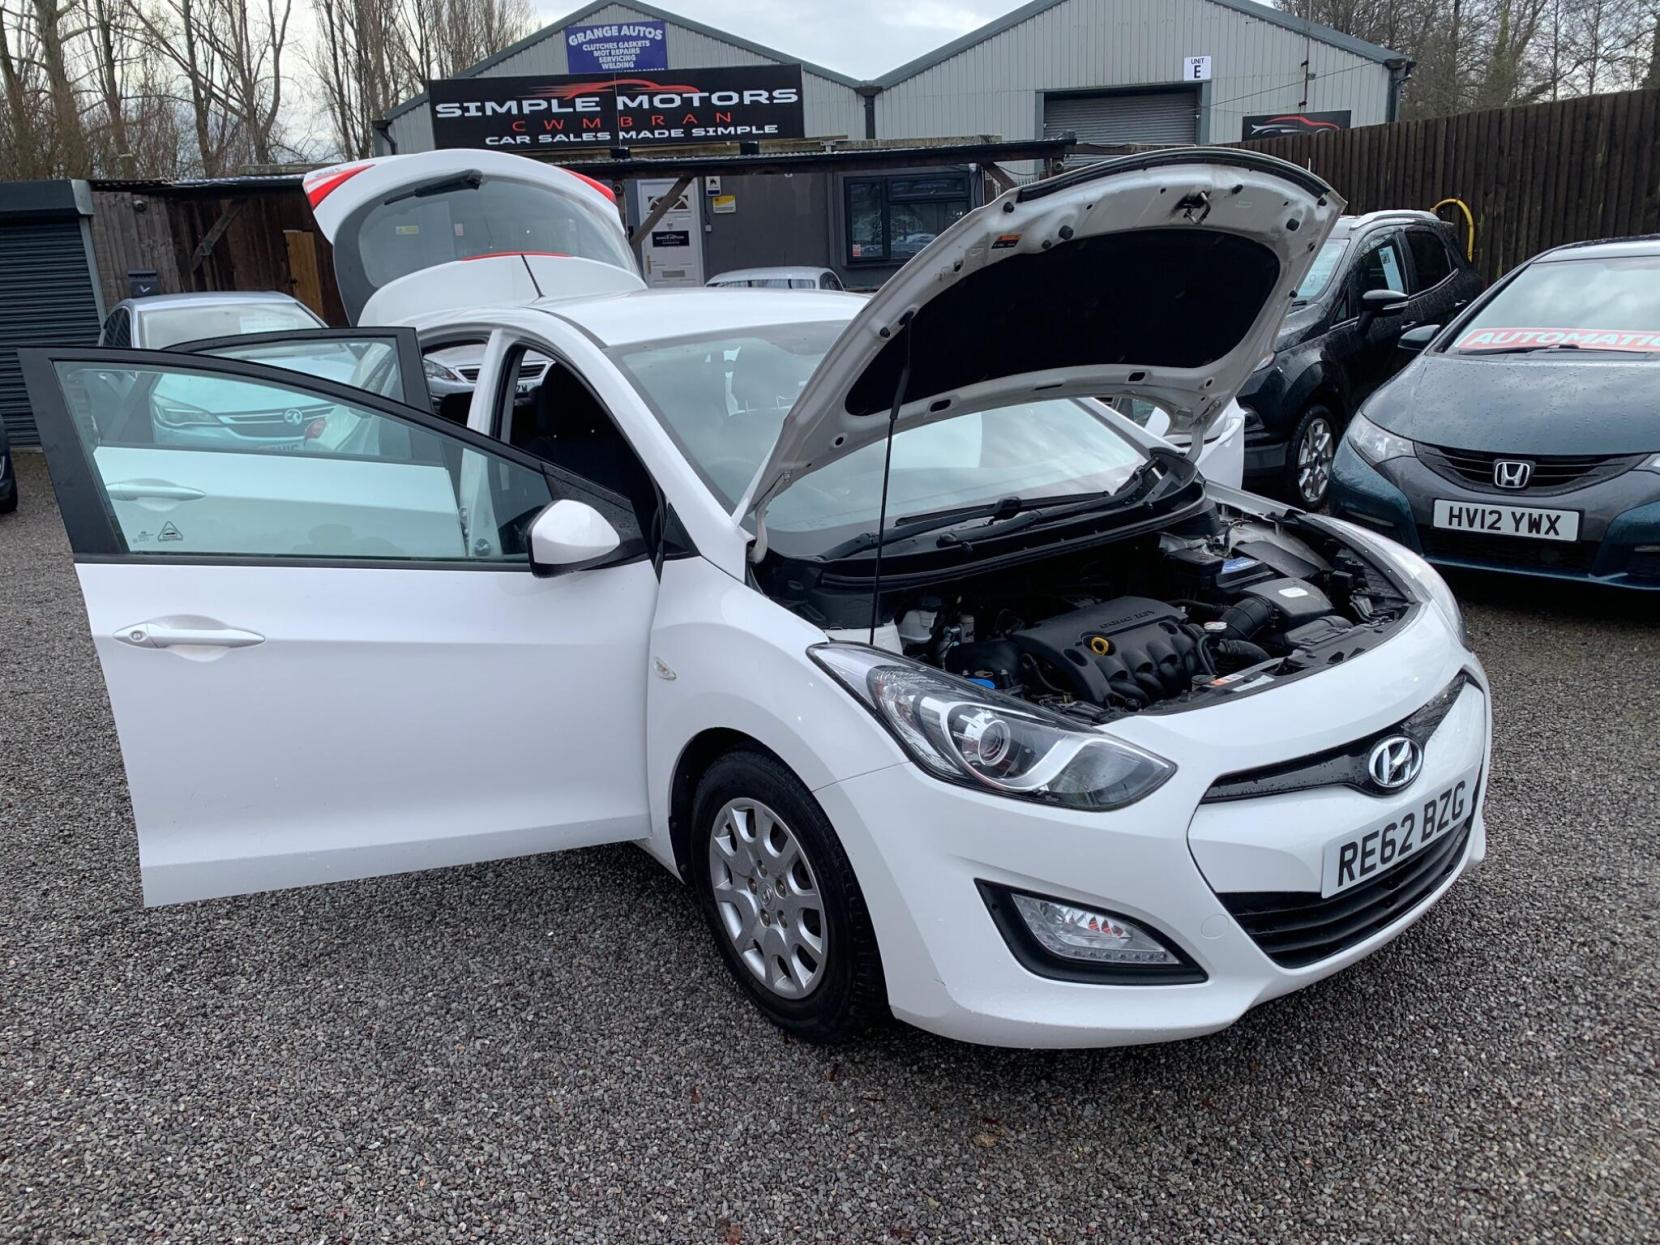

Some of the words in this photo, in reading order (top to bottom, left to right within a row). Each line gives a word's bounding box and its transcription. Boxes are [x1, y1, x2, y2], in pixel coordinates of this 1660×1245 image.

[568, 26, 618, 46] GRANGE
[621, 25, 663, 40] AUTOS
[582, 42, 617, 51] CLUTCHES
[618, 40, 650, 48] GASKETS
[610, 48, 640, 56] REPAIRS
[599, 54, 636, 63] SERVICING
[601, 61, 634, 70] WELDING
[1194, 65, 1201, 78] E
[435, 97, 601, 118] SIMPLE
[616, 89, 798, 110] MOTORS
[485, 135, 530, 145] CAR
[538, 132, 611, 143] SALES
[619, 129, 684, 139] MADE
[692, 125, 778, 136] SIMPLE
[1448, 506, 1502, 531] HV12
[1511, 511, 1561, 536] YWX
[1338, 812, 1415, 887] RE62
[1421, 780, 1465, 843] BZG
